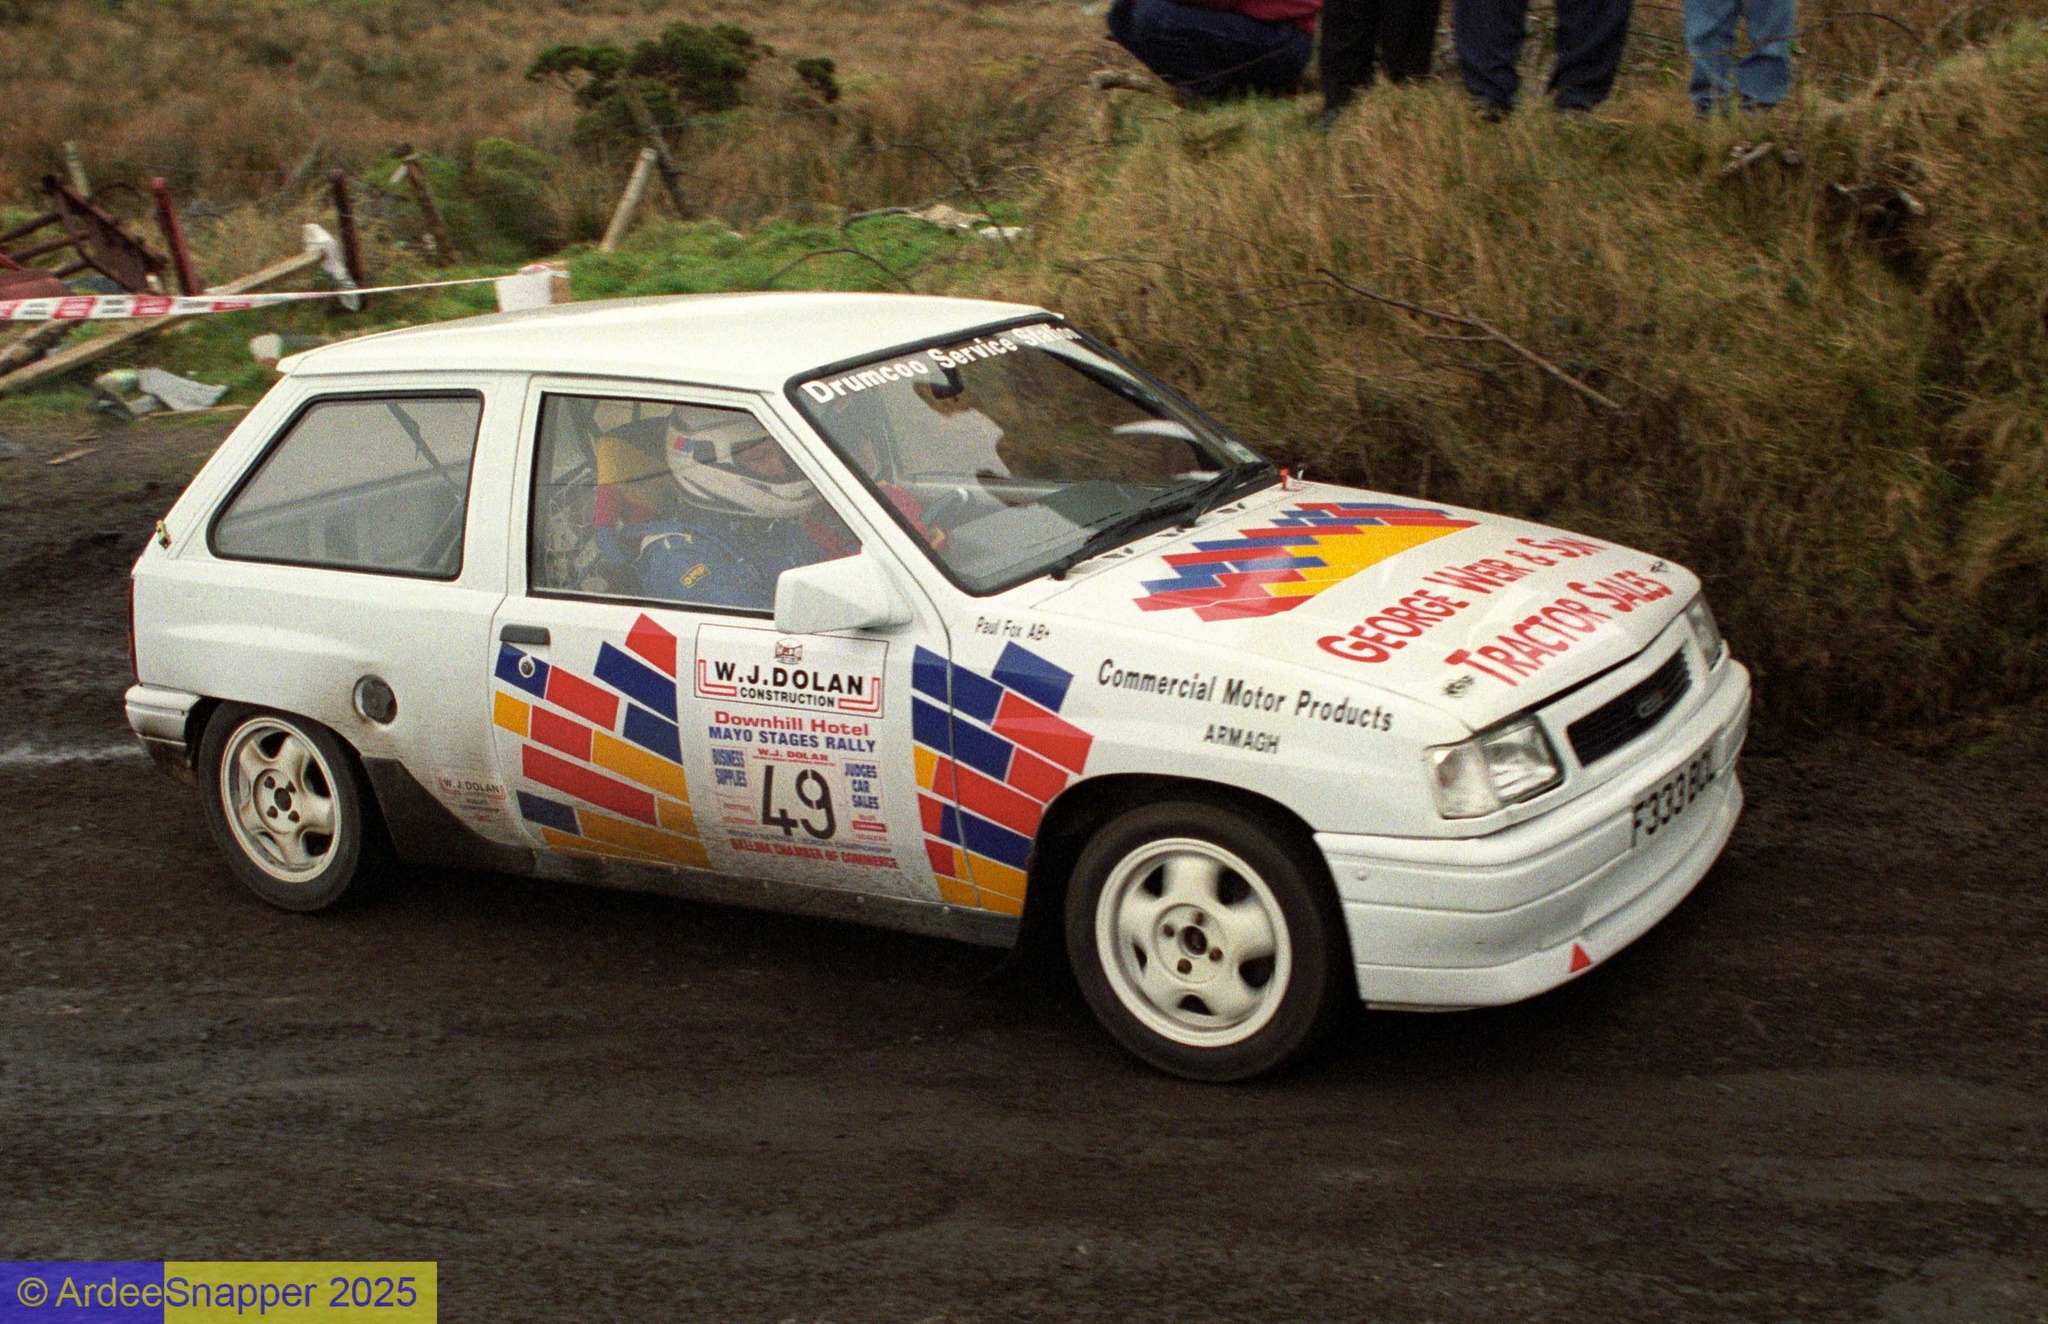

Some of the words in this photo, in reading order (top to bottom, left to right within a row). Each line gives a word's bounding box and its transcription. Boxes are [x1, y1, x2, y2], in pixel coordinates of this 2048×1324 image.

[800, 358, 928, 404] Drumcoo
[927, 337, 1018, 369] Service
[1316, 589, 1470, 663] GEORGE
[1422, 558, 1536, 594] WEIR
[1504, 549, 1558, 566] &
[975, 616, 1001, 635] Paul
[1444, 598, 1613, 687] TRACTOR
[1567, 570, 1673, 612] SALES
[740, 687, 835, 707] CONSTRUCTION
[1098, 659, 1217, 702] Commercial
[1222, 678, 1286, 713] Motor
[1294, 689, 1395, 732] Products
[715, 711, 803, 730] Downhill
[810, 719, 869, 736] Hotel
[708, 726, 753, 742] MAYO
[760, 731, 819, 748] STAGES
[825, 737, 875, 753] RALLY
[1204, 724, 1280, 754] ARMAGH
[712, 748, 745, 768] BUSINESS
[787, 751, 829, 761] DOLAN
[715, 768, 747, 787] SUPPLIES
[845, 763, 877, 778] JUDGES
[852, 779, 870, 792] CAR
[762, 765, 836, 840] 49
[852, 795, 879, 809] SALES
